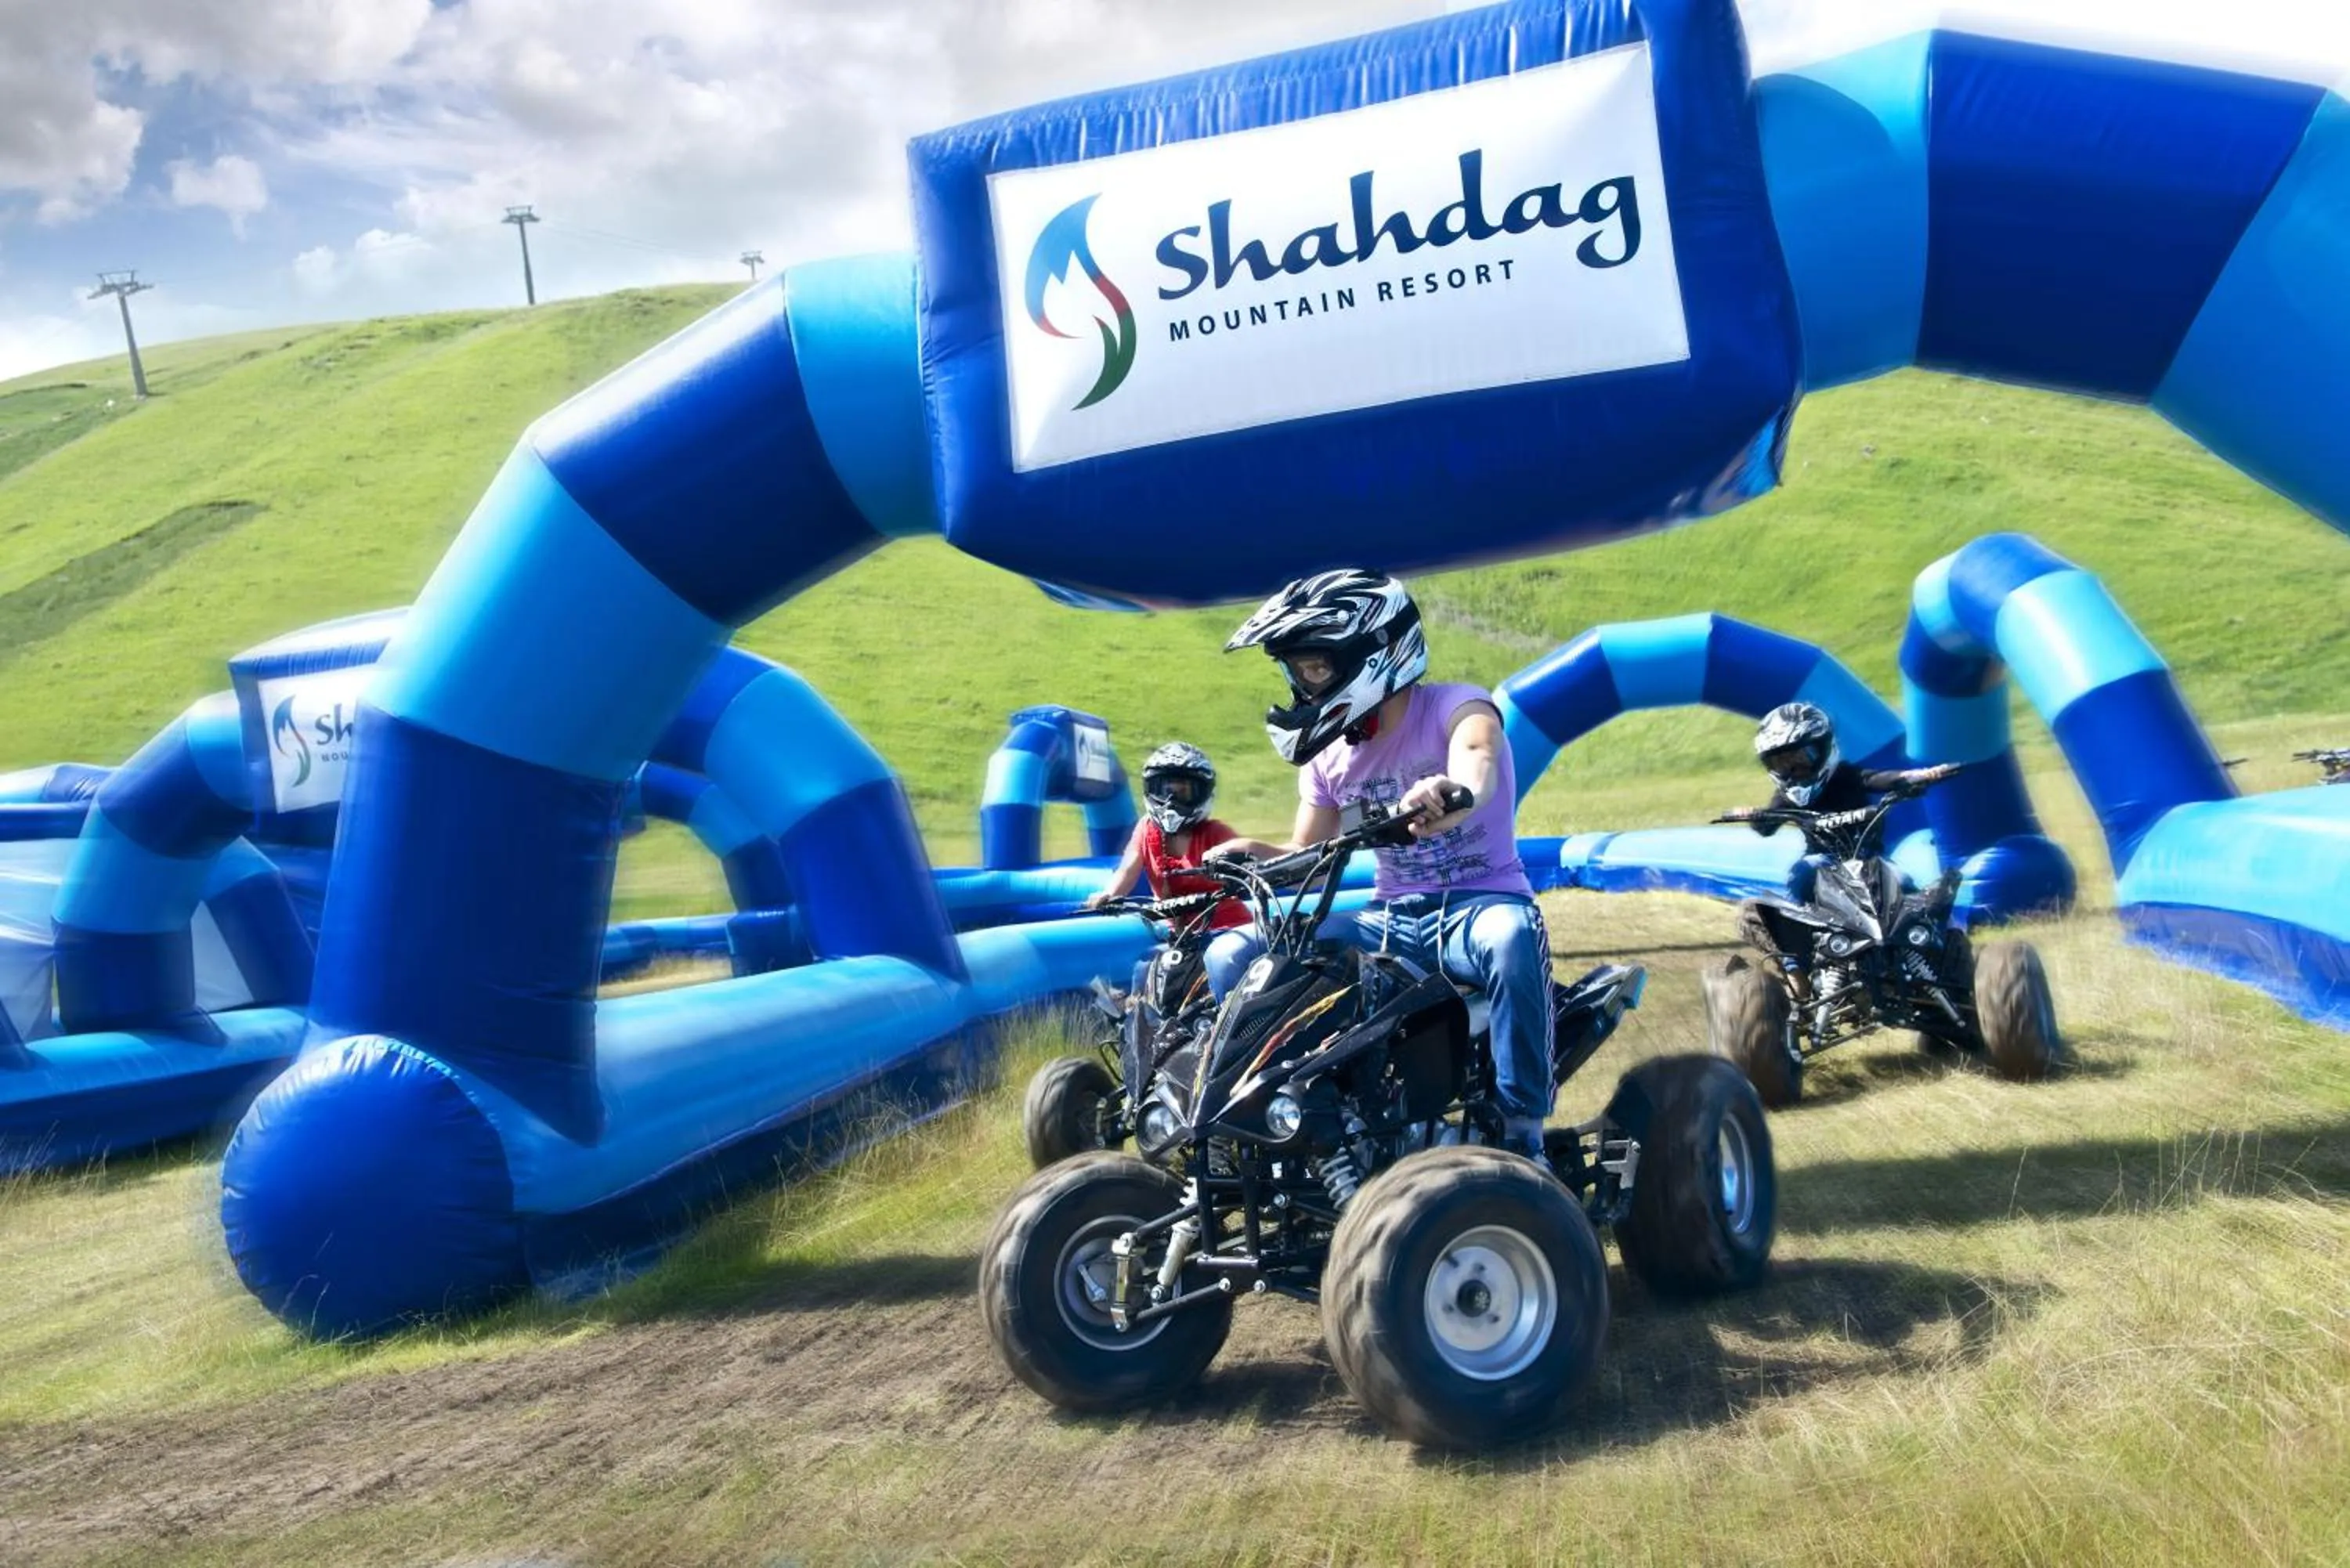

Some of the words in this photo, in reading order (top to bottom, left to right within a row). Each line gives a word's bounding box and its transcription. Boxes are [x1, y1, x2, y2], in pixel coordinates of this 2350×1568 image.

[1155, 149, 1641, 300] Shahdag
[1170, 287, 1355, 341] MOUNTAIN
[1376, 259, 1515, 302] RESORT
